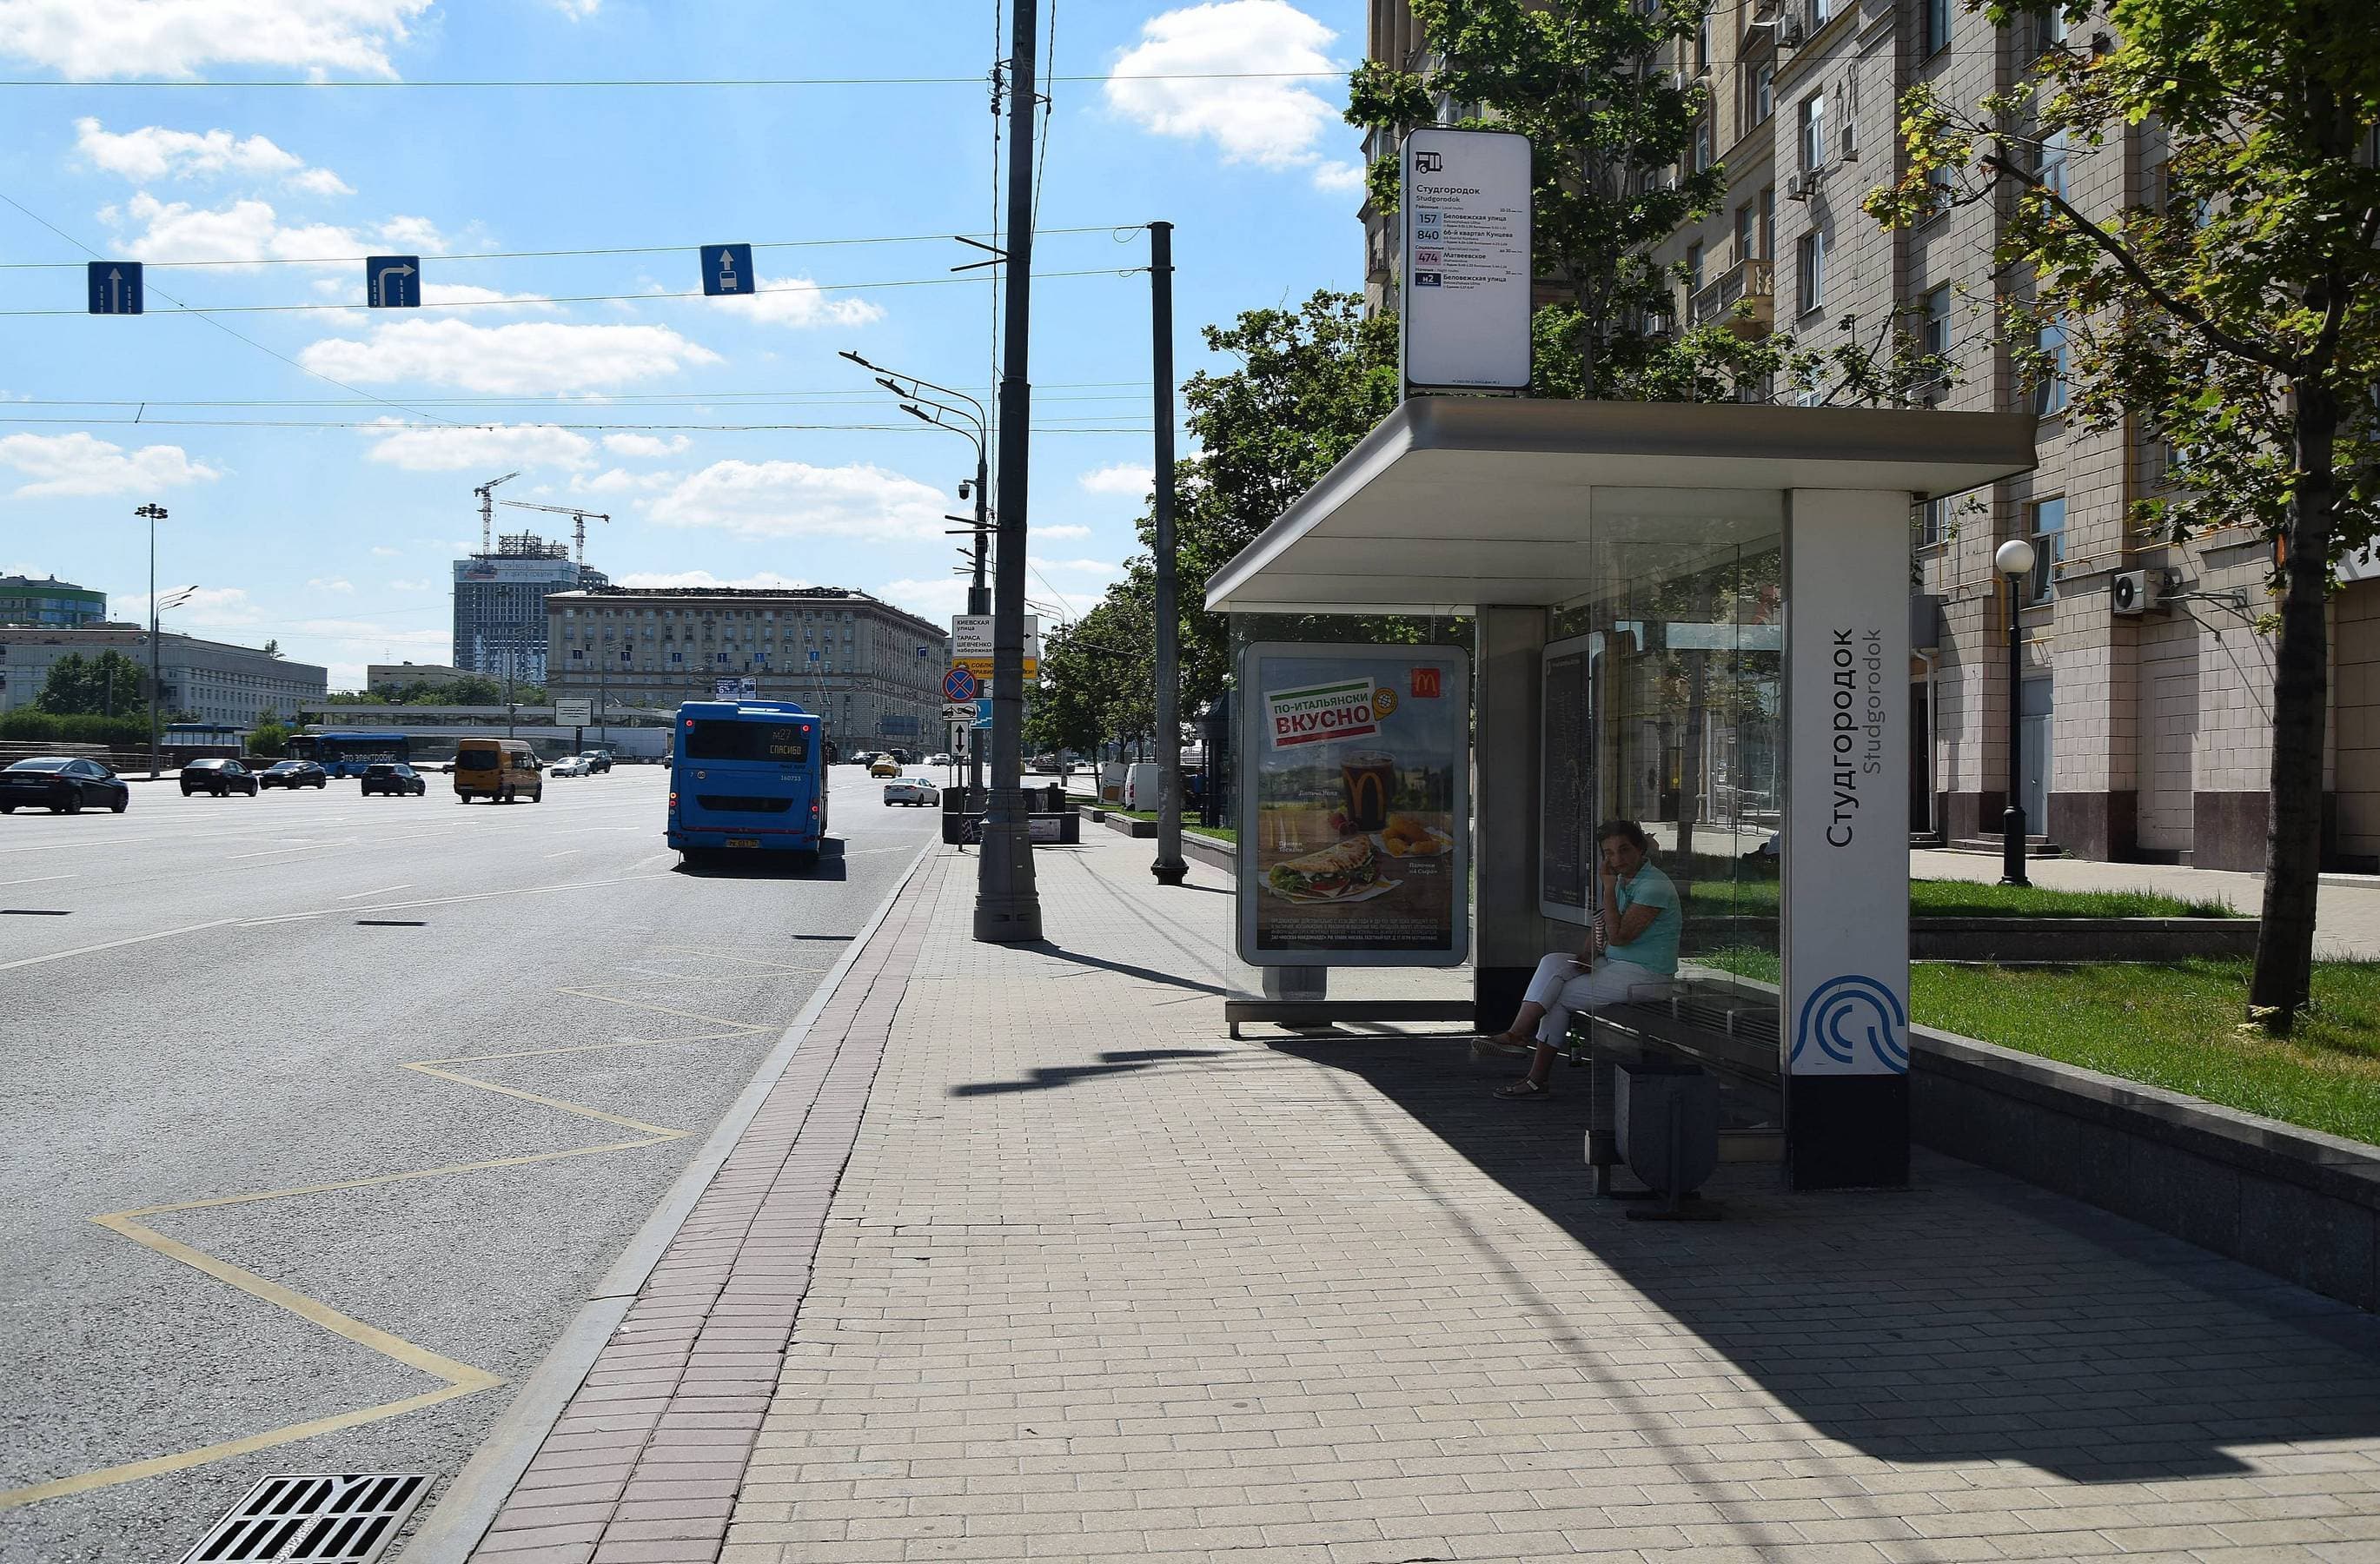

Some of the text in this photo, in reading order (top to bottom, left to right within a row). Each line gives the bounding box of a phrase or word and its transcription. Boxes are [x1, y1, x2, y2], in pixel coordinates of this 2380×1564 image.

[1416, 184, 1481, 195] Студгородок
[1420, 214, 1437, 223] 157
[1417, 230, 1440, 240] 840
[1418, 253, 1438, 262] 474
[1274, 693, 1369, 714] ПО-ИТАЛЬЯНСКИ
[1862, 629, 1886, 774] Studgorodok
[1276, 705, 1370, 734] ВКУСНО
[1826, 627, 1860, 847] Студгородок
[770, 745, 801, 755] СПАСИБО
[340, 752, 354, 763] Это
